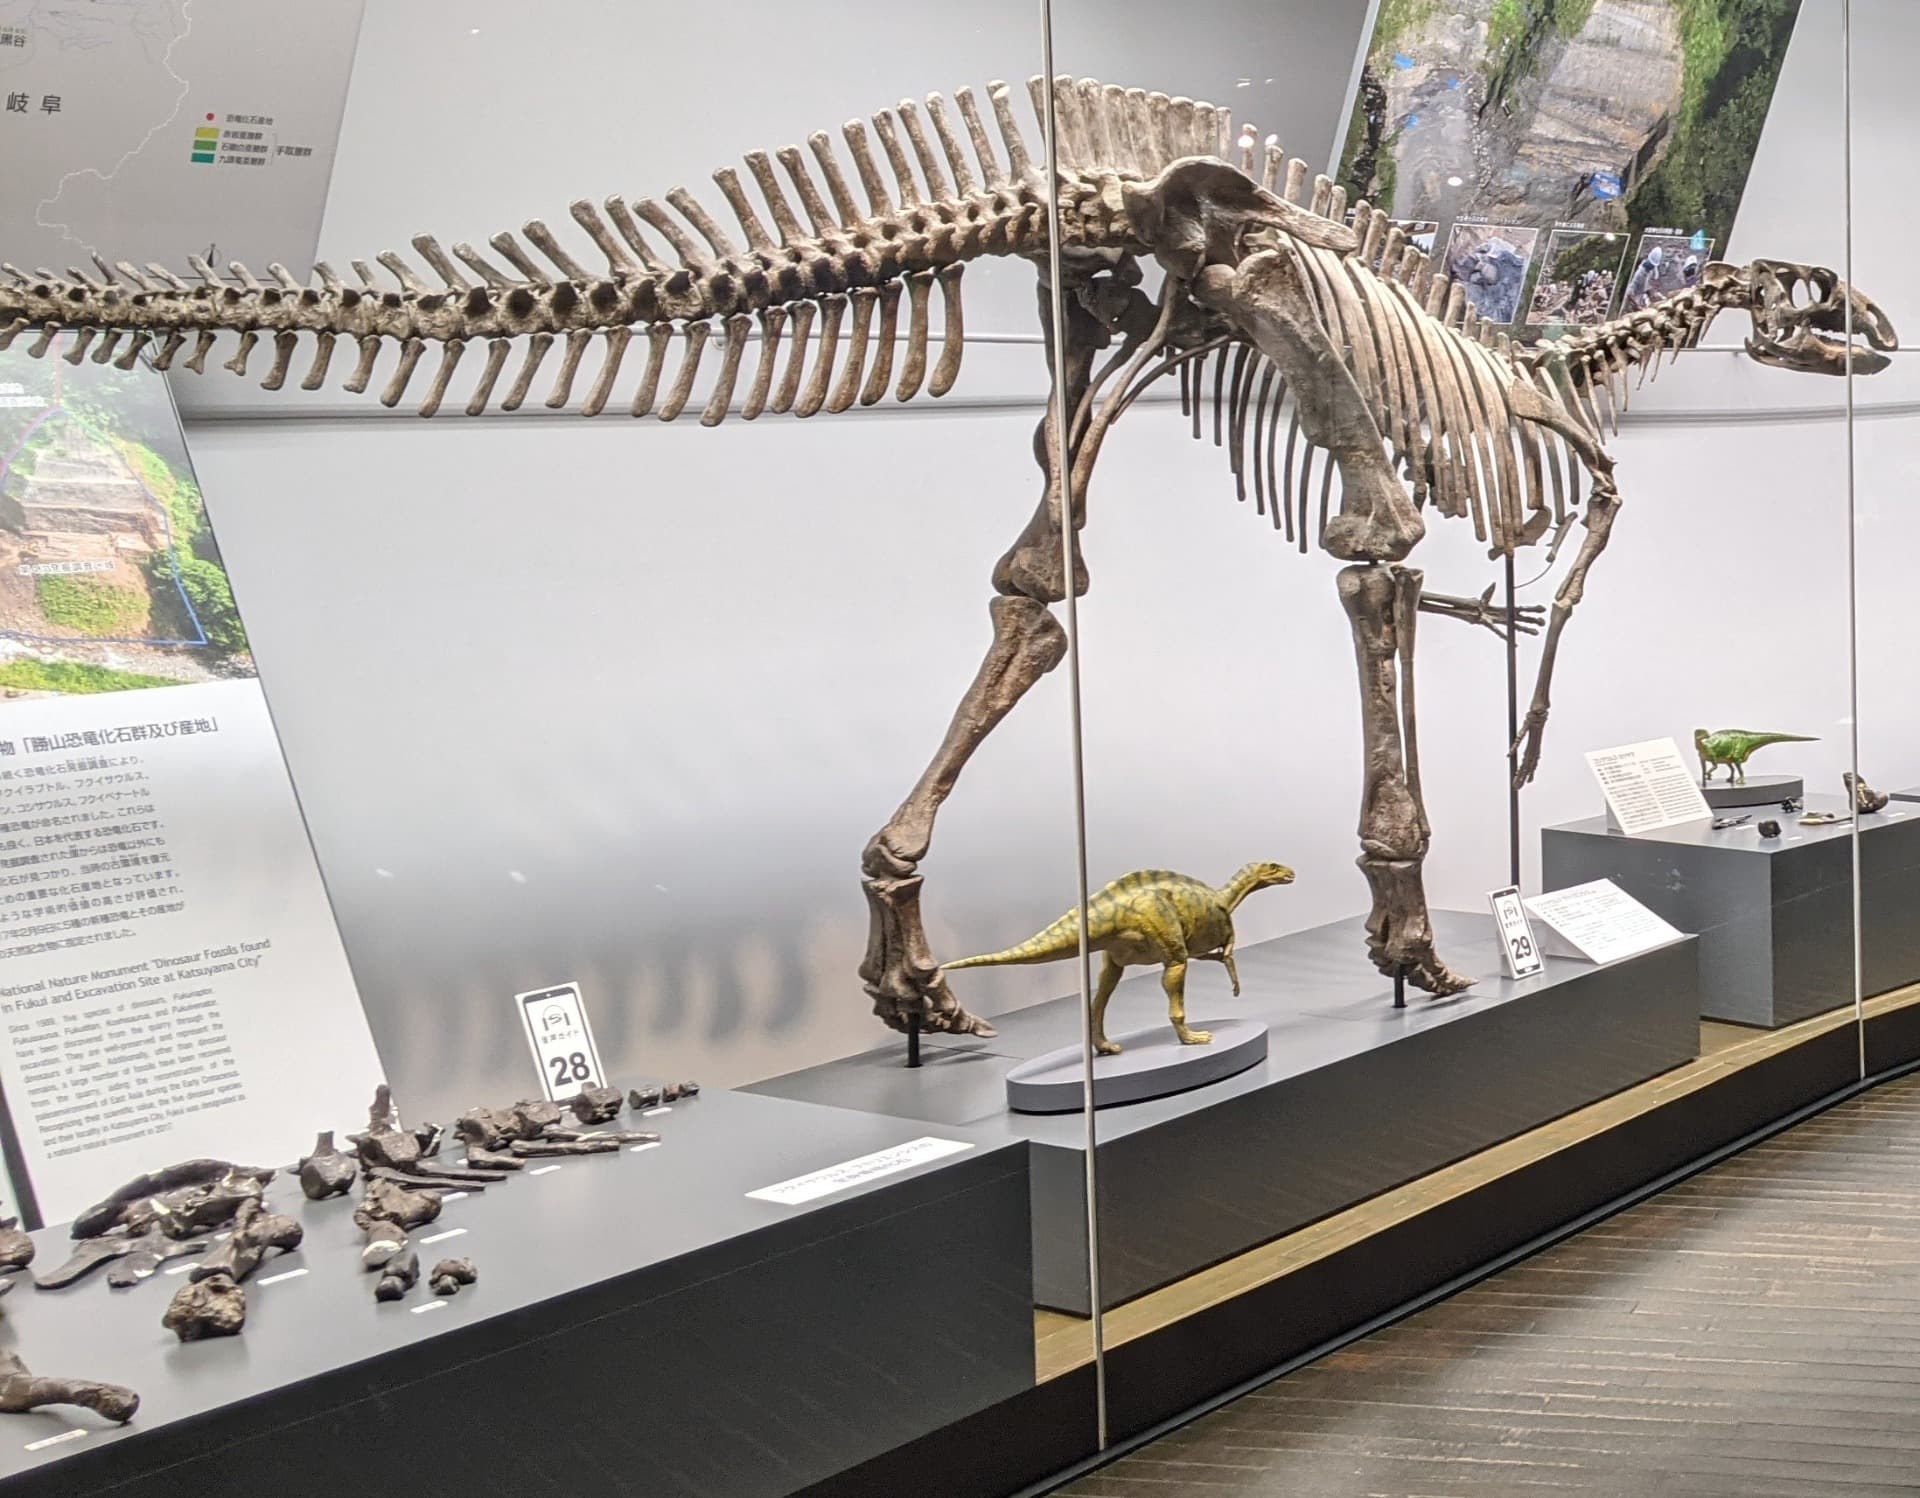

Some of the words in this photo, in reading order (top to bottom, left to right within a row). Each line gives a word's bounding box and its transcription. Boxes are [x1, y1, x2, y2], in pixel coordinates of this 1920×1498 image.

[6, 91, 62, 115] 岐阜
[48, 975, 88, 988] Nature
[91, 962, 150, 980] Monument
[204, 946, 238, 959] Fossils
[240, 939, 270, 952] found
[1511, 935, 1532, 960] 29
[15, 997, 48, 1010] Fukui
[51, 991, 73, 1004] and
[74, 981, 136, 999] Excavation
[138, 977, 160, 987] Site
[163, 973, 176, 982] at
[177, 963, 236, 980] Katsuyama
[549, 1052, 590, 1087] 28
